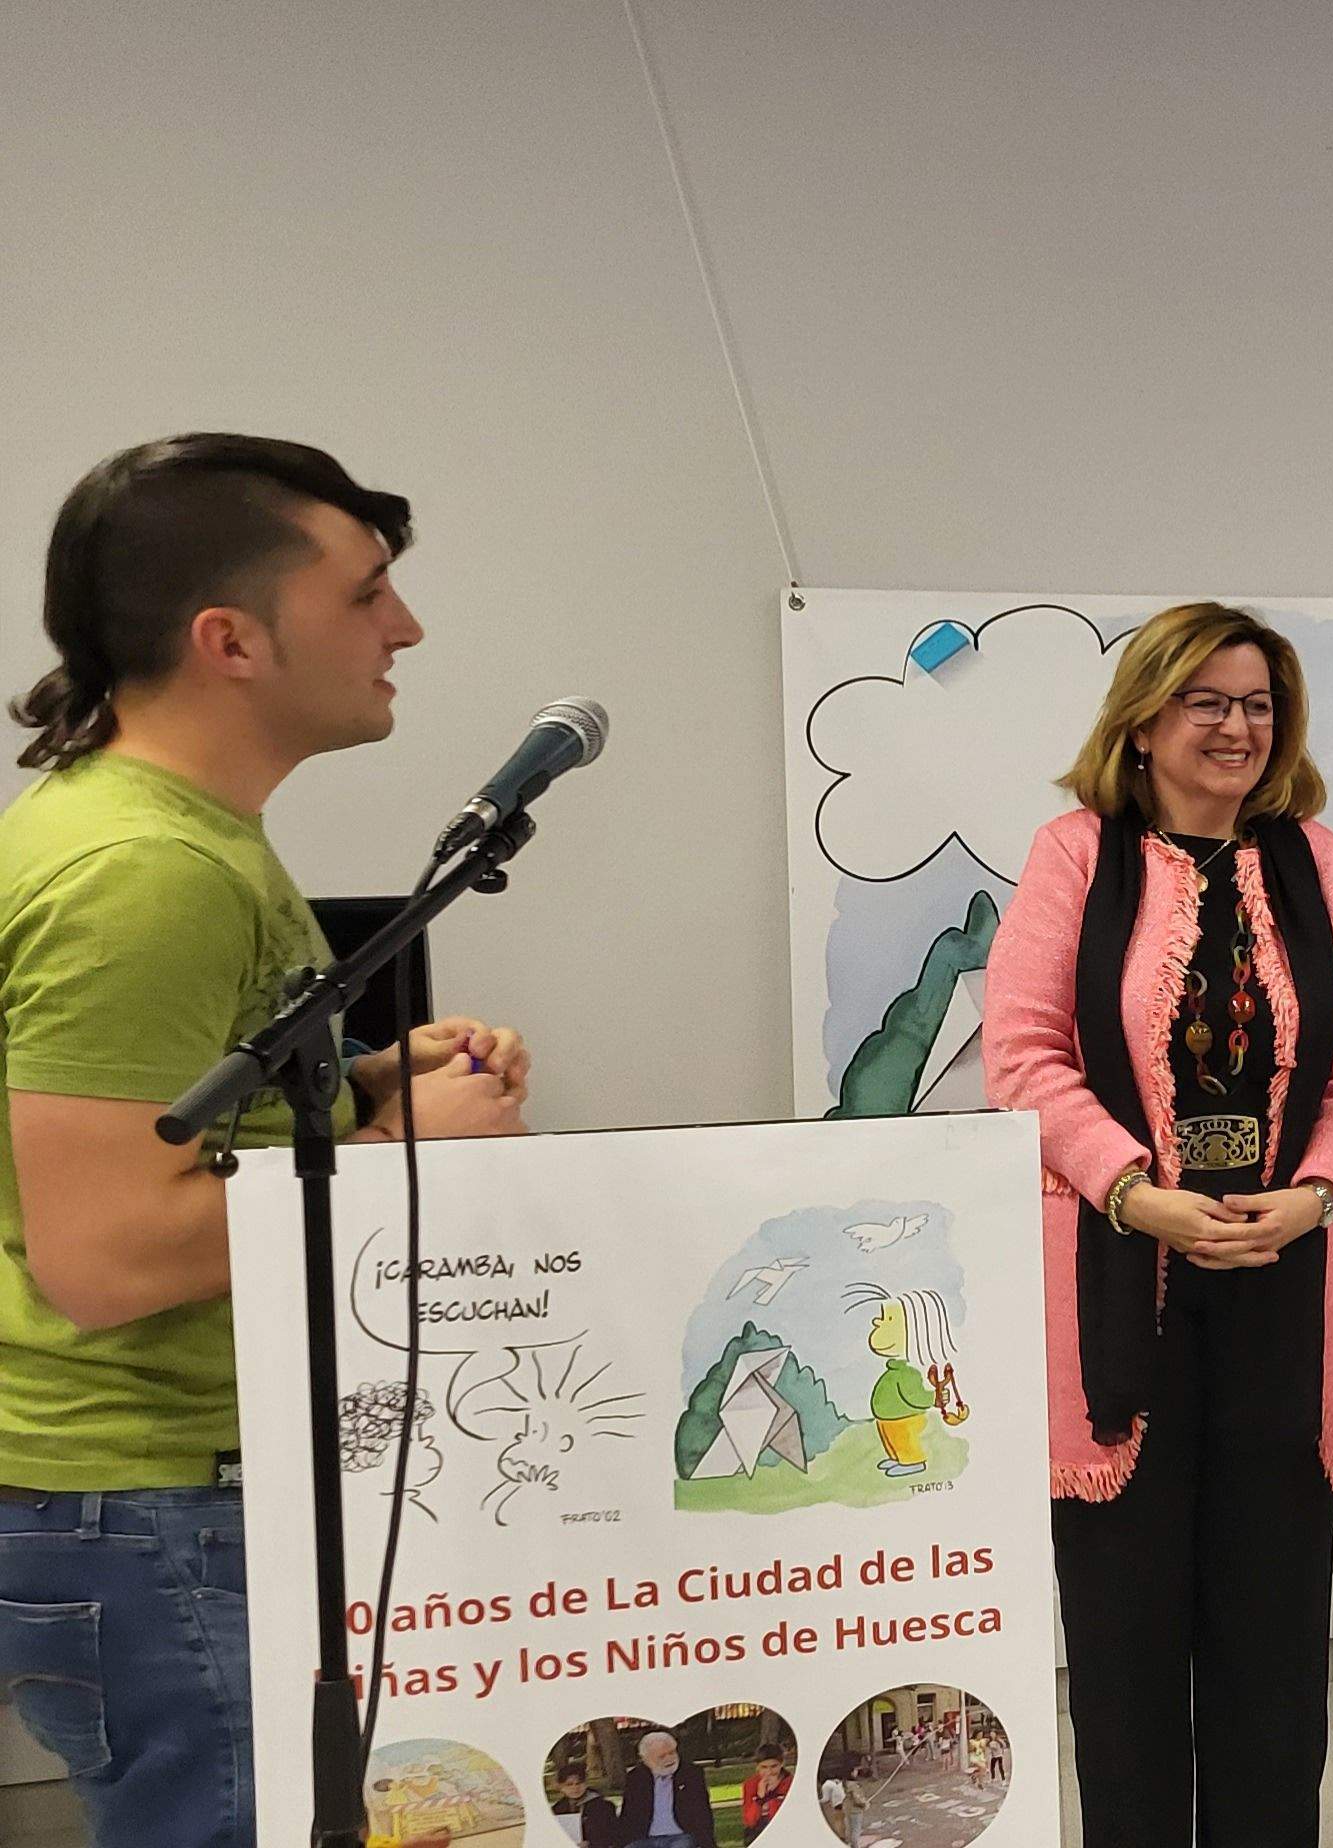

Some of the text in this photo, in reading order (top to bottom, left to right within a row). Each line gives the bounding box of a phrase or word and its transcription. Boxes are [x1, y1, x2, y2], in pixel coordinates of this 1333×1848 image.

[534, 1250, 582, 1274] NOS
[417, 1289, 549, 1323] ESCUCHAN!
[346, 1544, 995, 1635] 0 años de La Ciudad de las
[314, 1606, 1002, 1701] iñas y los Niños de Huesca
